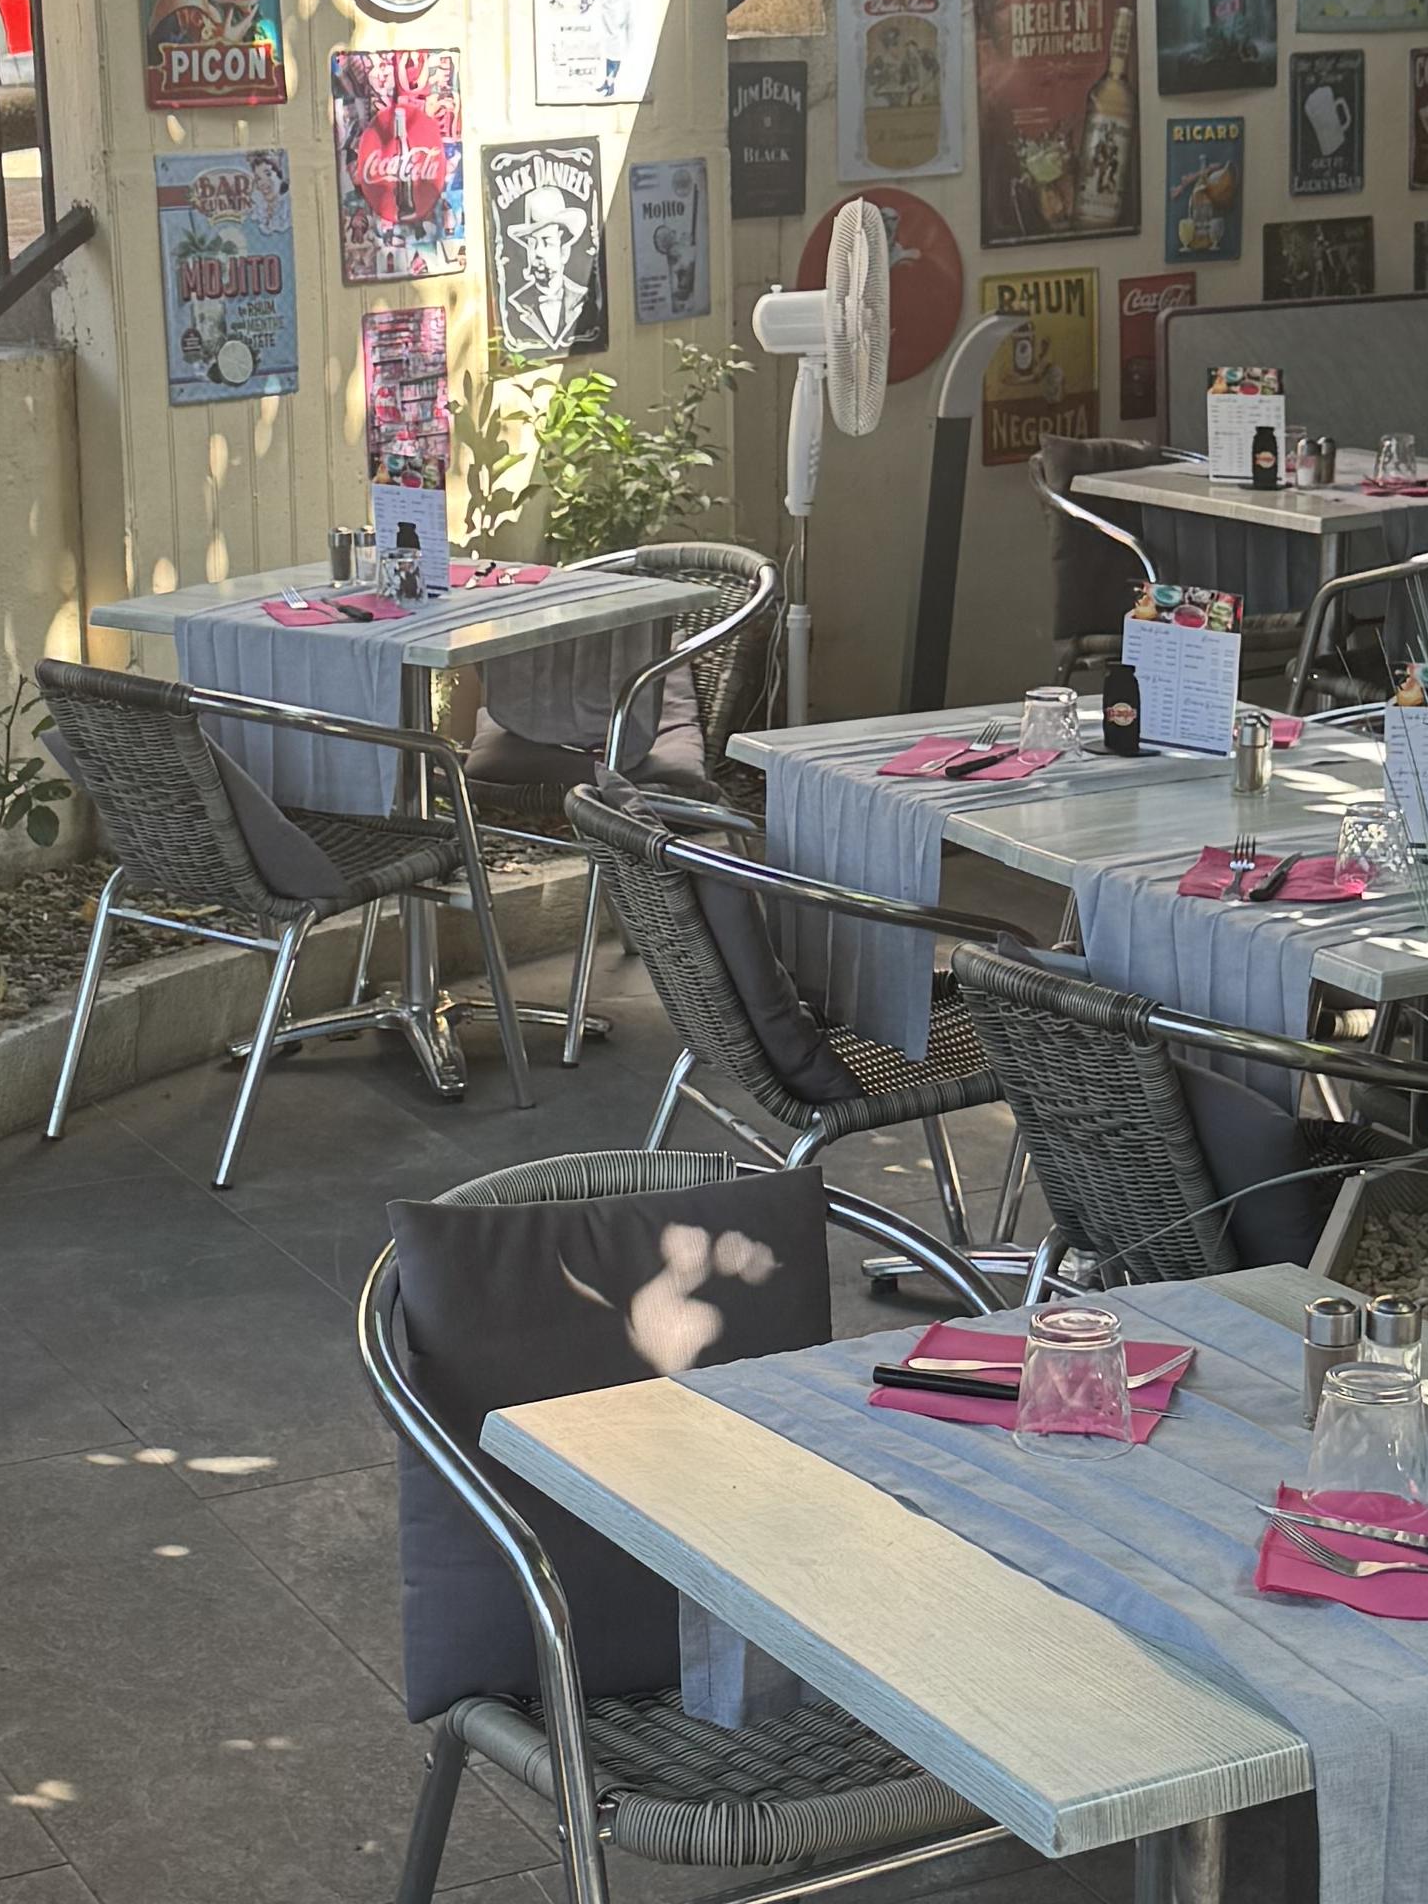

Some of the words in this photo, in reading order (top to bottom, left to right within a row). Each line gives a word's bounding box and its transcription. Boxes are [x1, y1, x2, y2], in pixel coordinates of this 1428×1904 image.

[172, 48, 266, 83] PICON
[733, 84, 762, 117] JIM
[762, 76, 801, 112] BEAM
[1173, 125, 1240, 141] RICARD
[744, 148, 790, 164] BLACK
[196, 175, 253, 198] BAR
[495, 164, 535, 209] JACK
[643, 201, 685, 221] Mojito
[179, 255, 282, 302] MOJITO
[997, 279, 1086, 317] RHUM
